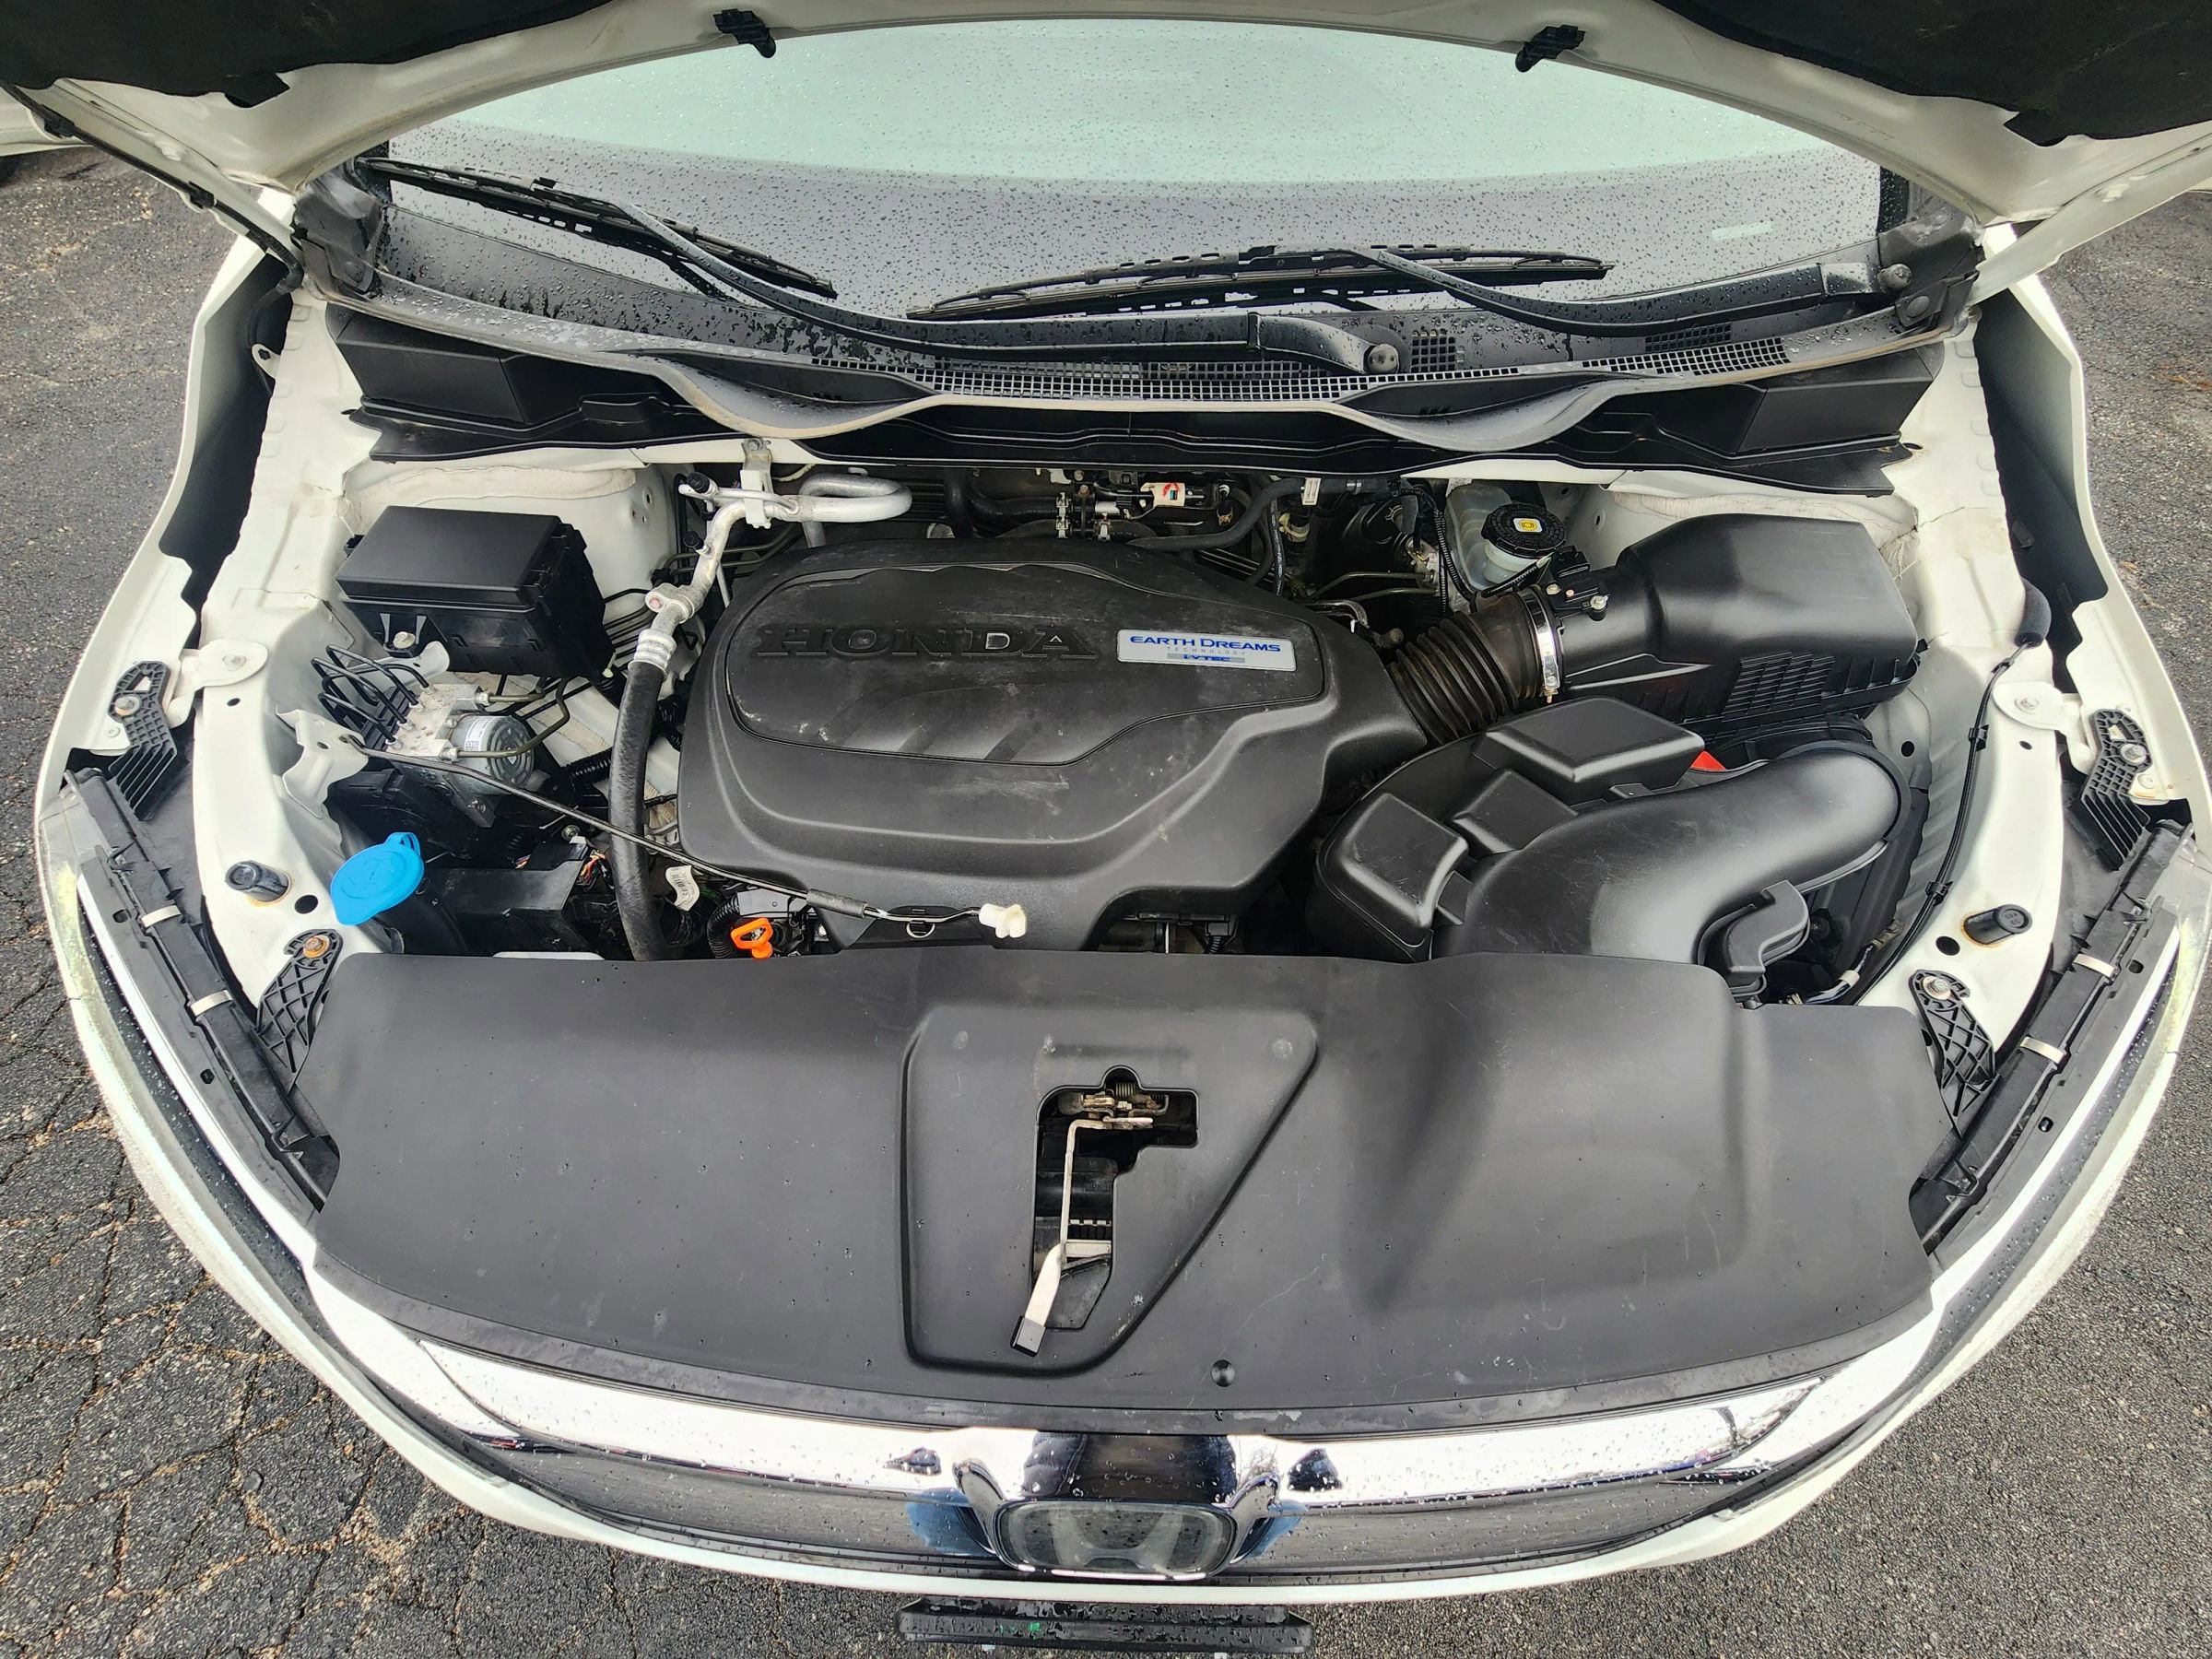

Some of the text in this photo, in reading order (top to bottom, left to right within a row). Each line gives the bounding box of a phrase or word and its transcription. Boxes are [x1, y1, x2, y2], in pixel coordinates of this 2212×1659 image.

[756, 628, 1099, 660] HONDA
[1130, 636, 1281, 652] EARTH DREAMS
